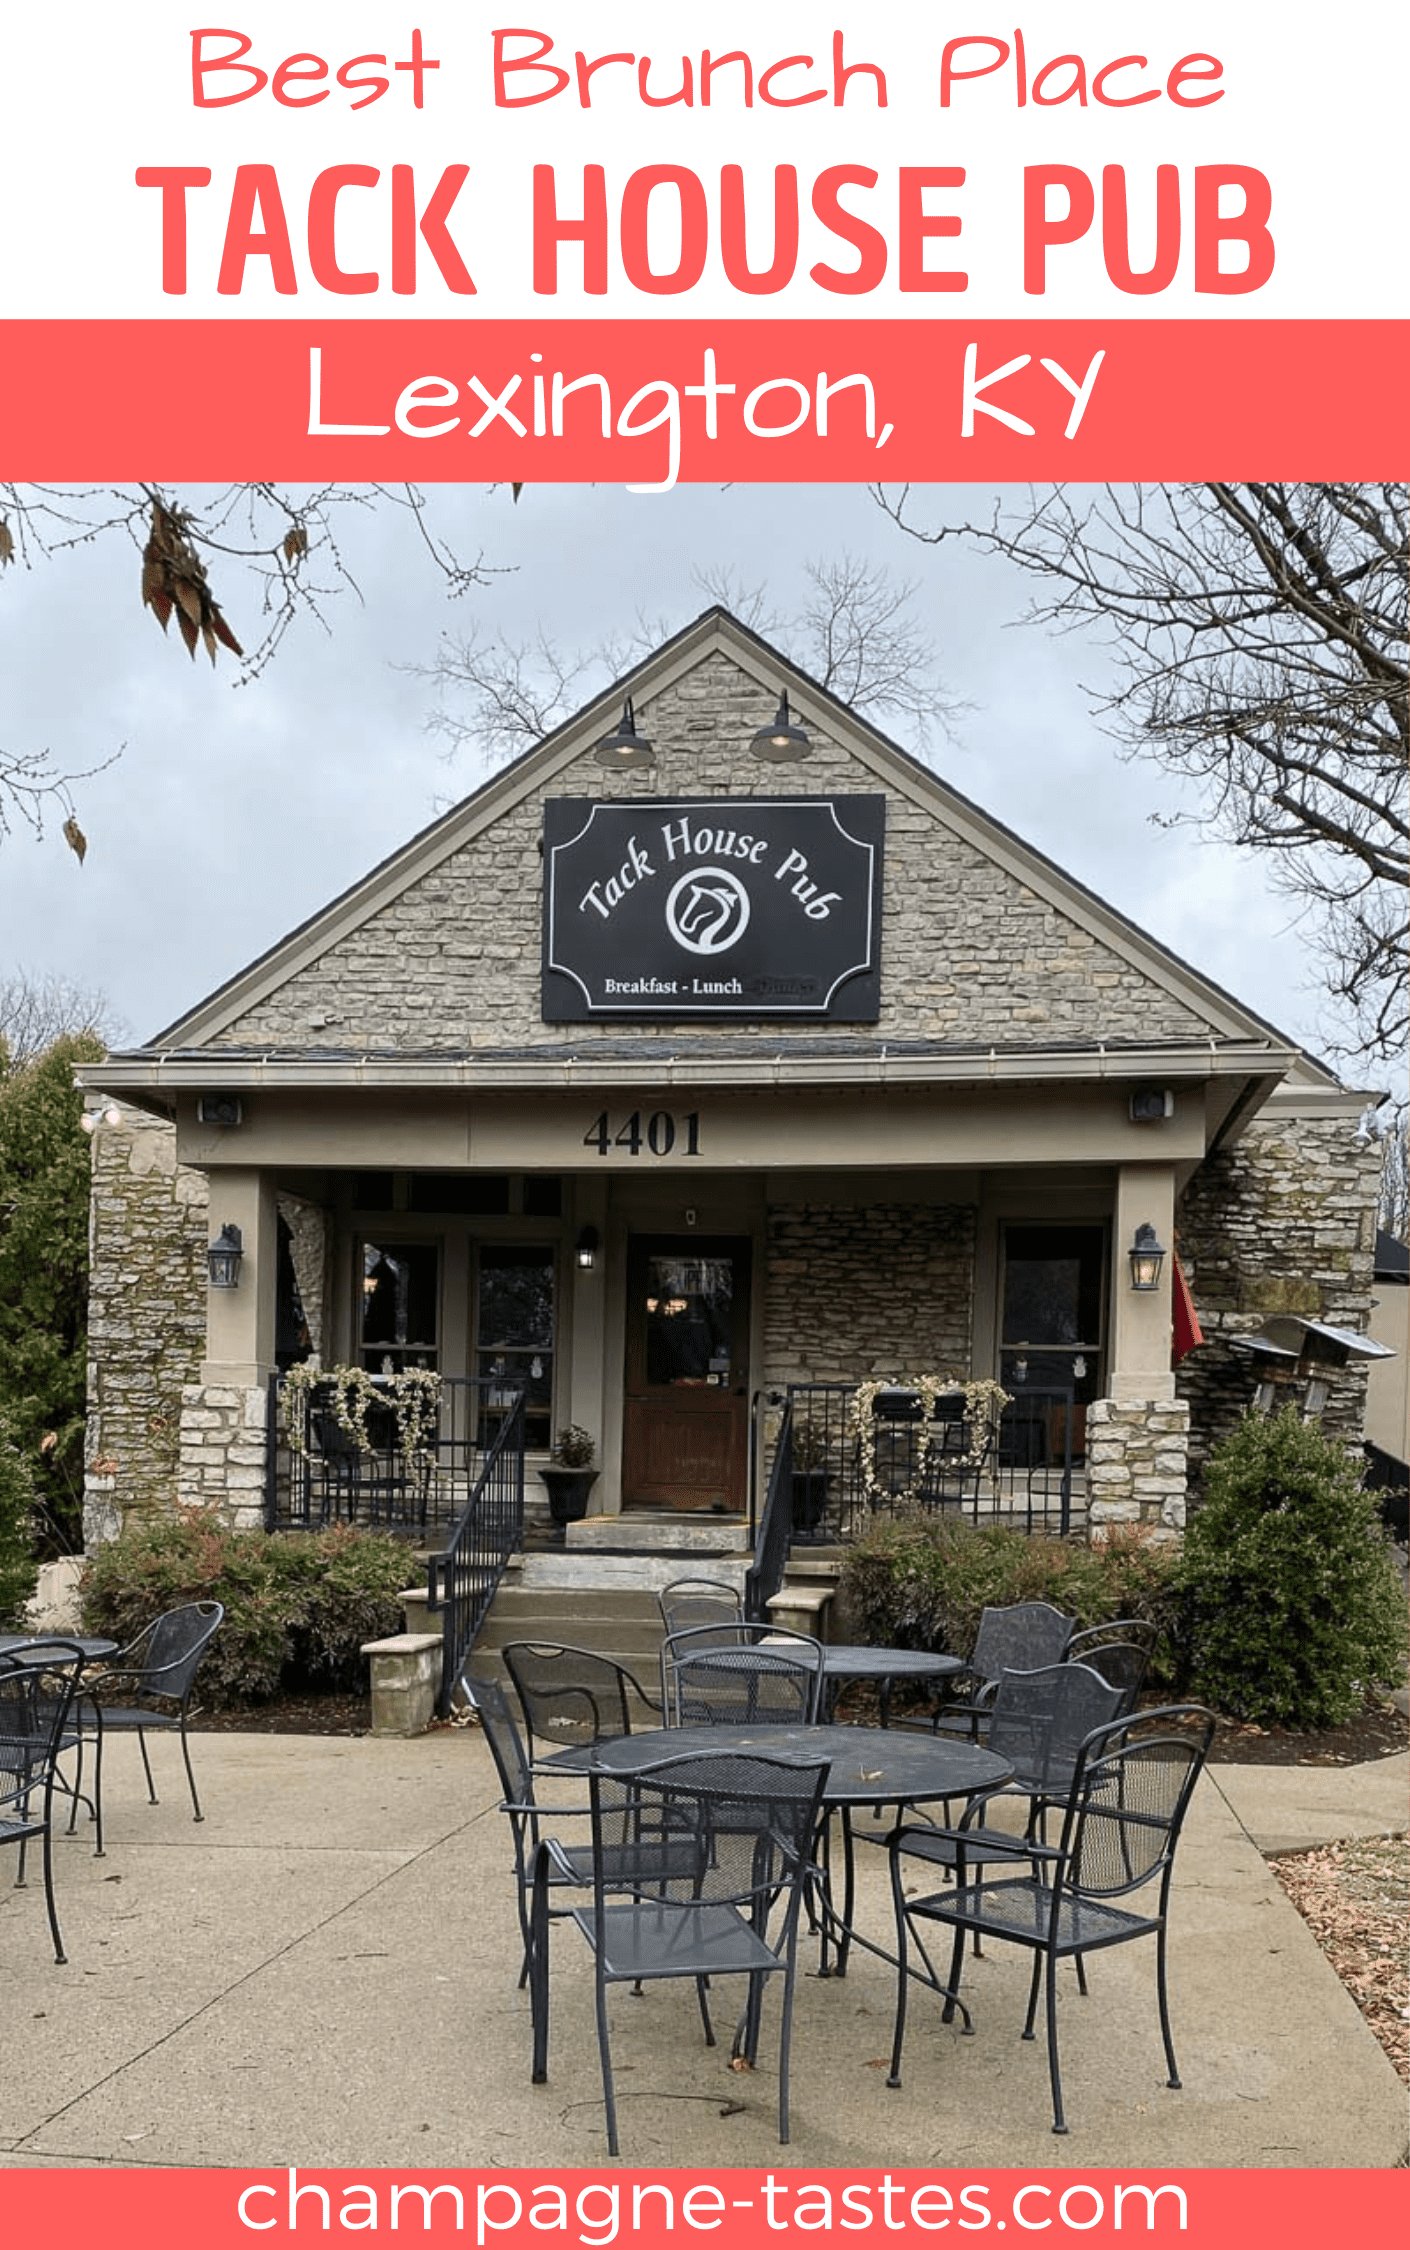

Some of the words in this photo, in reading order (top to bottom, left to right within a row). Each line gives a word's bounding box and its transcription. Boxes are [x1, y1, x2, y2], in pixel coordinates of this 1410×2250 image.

[579, 835, 657, 919] Tack
[661, 816, 769, 864] House
[773, 848, 843, 920] Pub
[604, 977, 678, 995] Breakfast
[692, 977, 743, 995] Lunch
[583, 1111, 703, 1157] 4401
